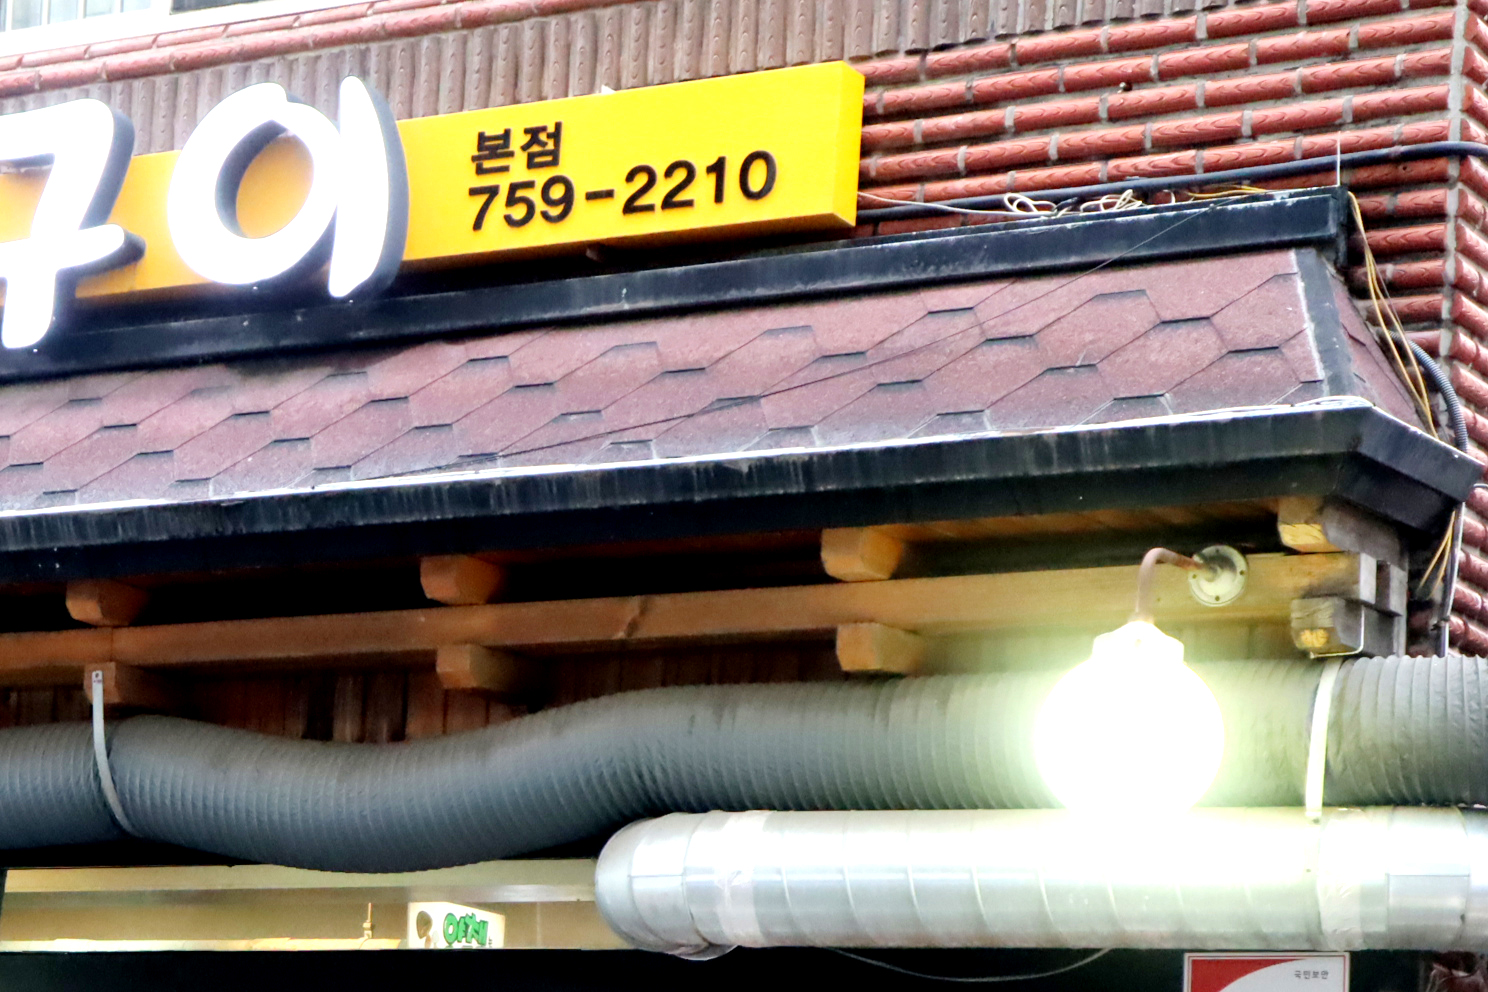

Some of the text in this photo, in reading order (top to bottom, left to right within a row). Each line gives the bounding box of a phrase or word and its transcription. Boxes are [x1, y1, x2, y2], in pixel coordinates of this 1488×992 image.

[471, 121, 563, 176] 본점
[468, 149, 778, 231] 759-2210
[1293, 969, 1330, 980] 국민보안
